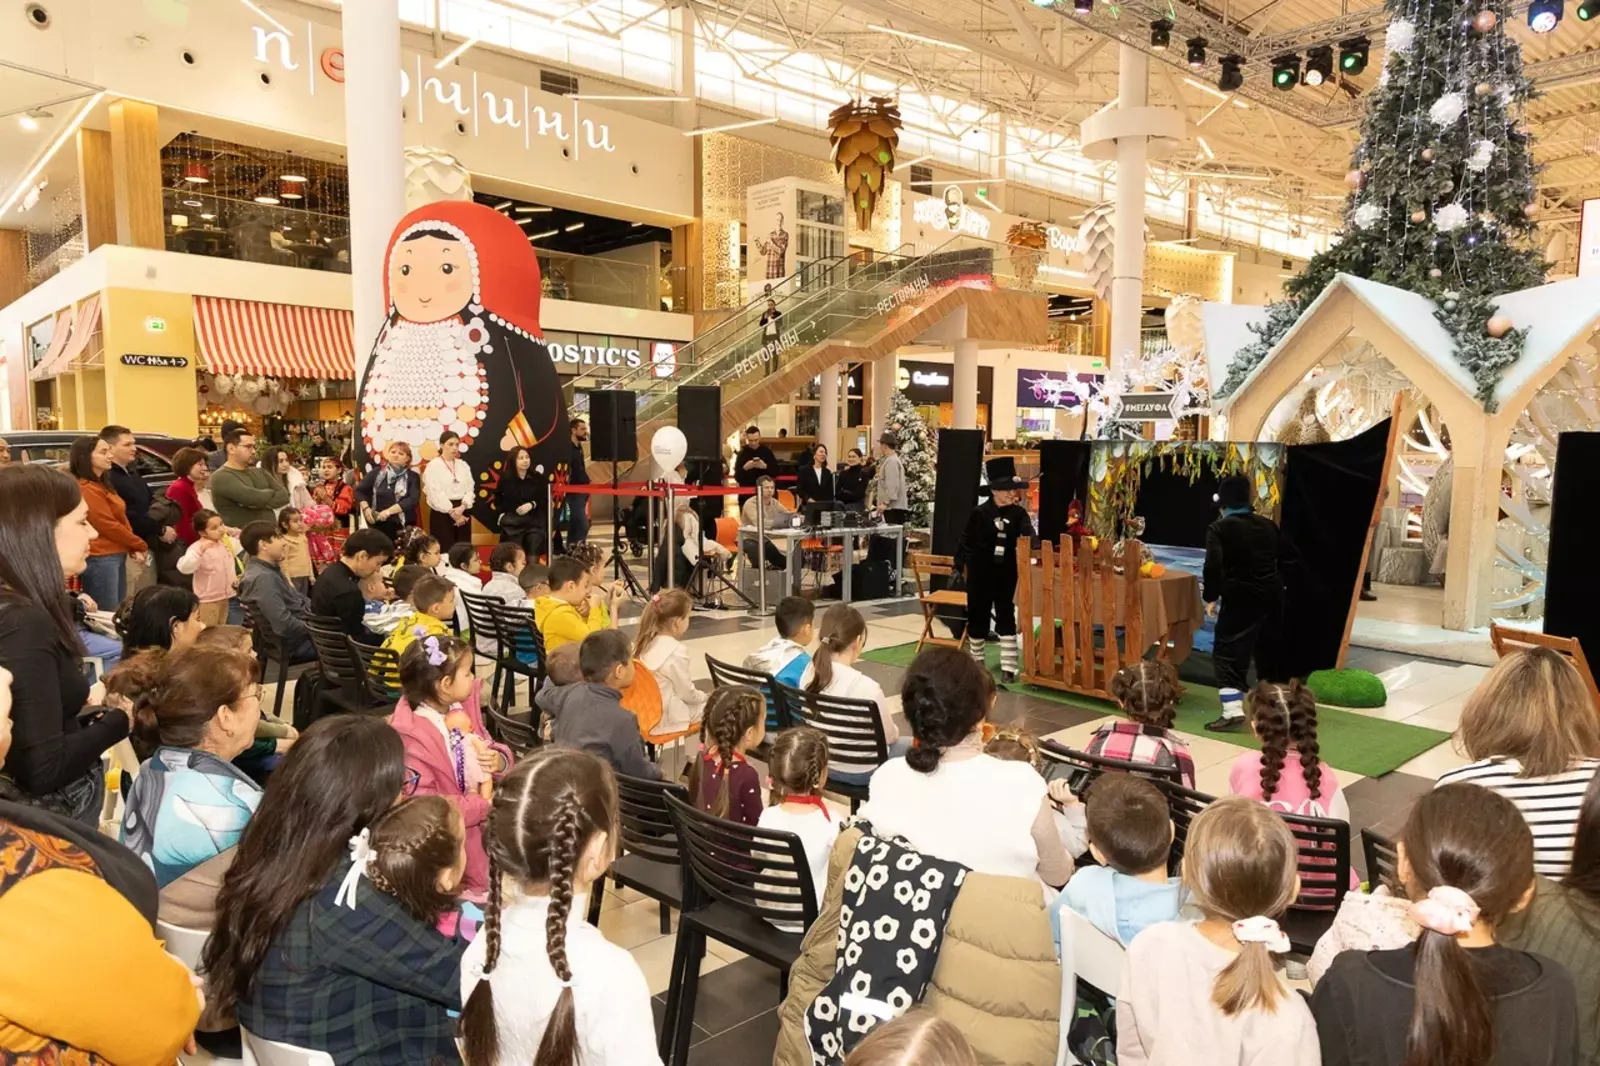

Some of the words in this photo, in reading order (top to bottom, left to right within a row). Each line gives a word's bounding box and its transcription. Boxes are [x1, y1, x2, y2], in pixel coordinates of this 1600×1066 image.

[876, 273, 930, 316] РЕСТОРАНЫ
[124, 355, 146, 365] WC
[547, 342, 641, 368] OSTIC'S
[734, 327, 800, 378] РЕСТОРАНЫ
